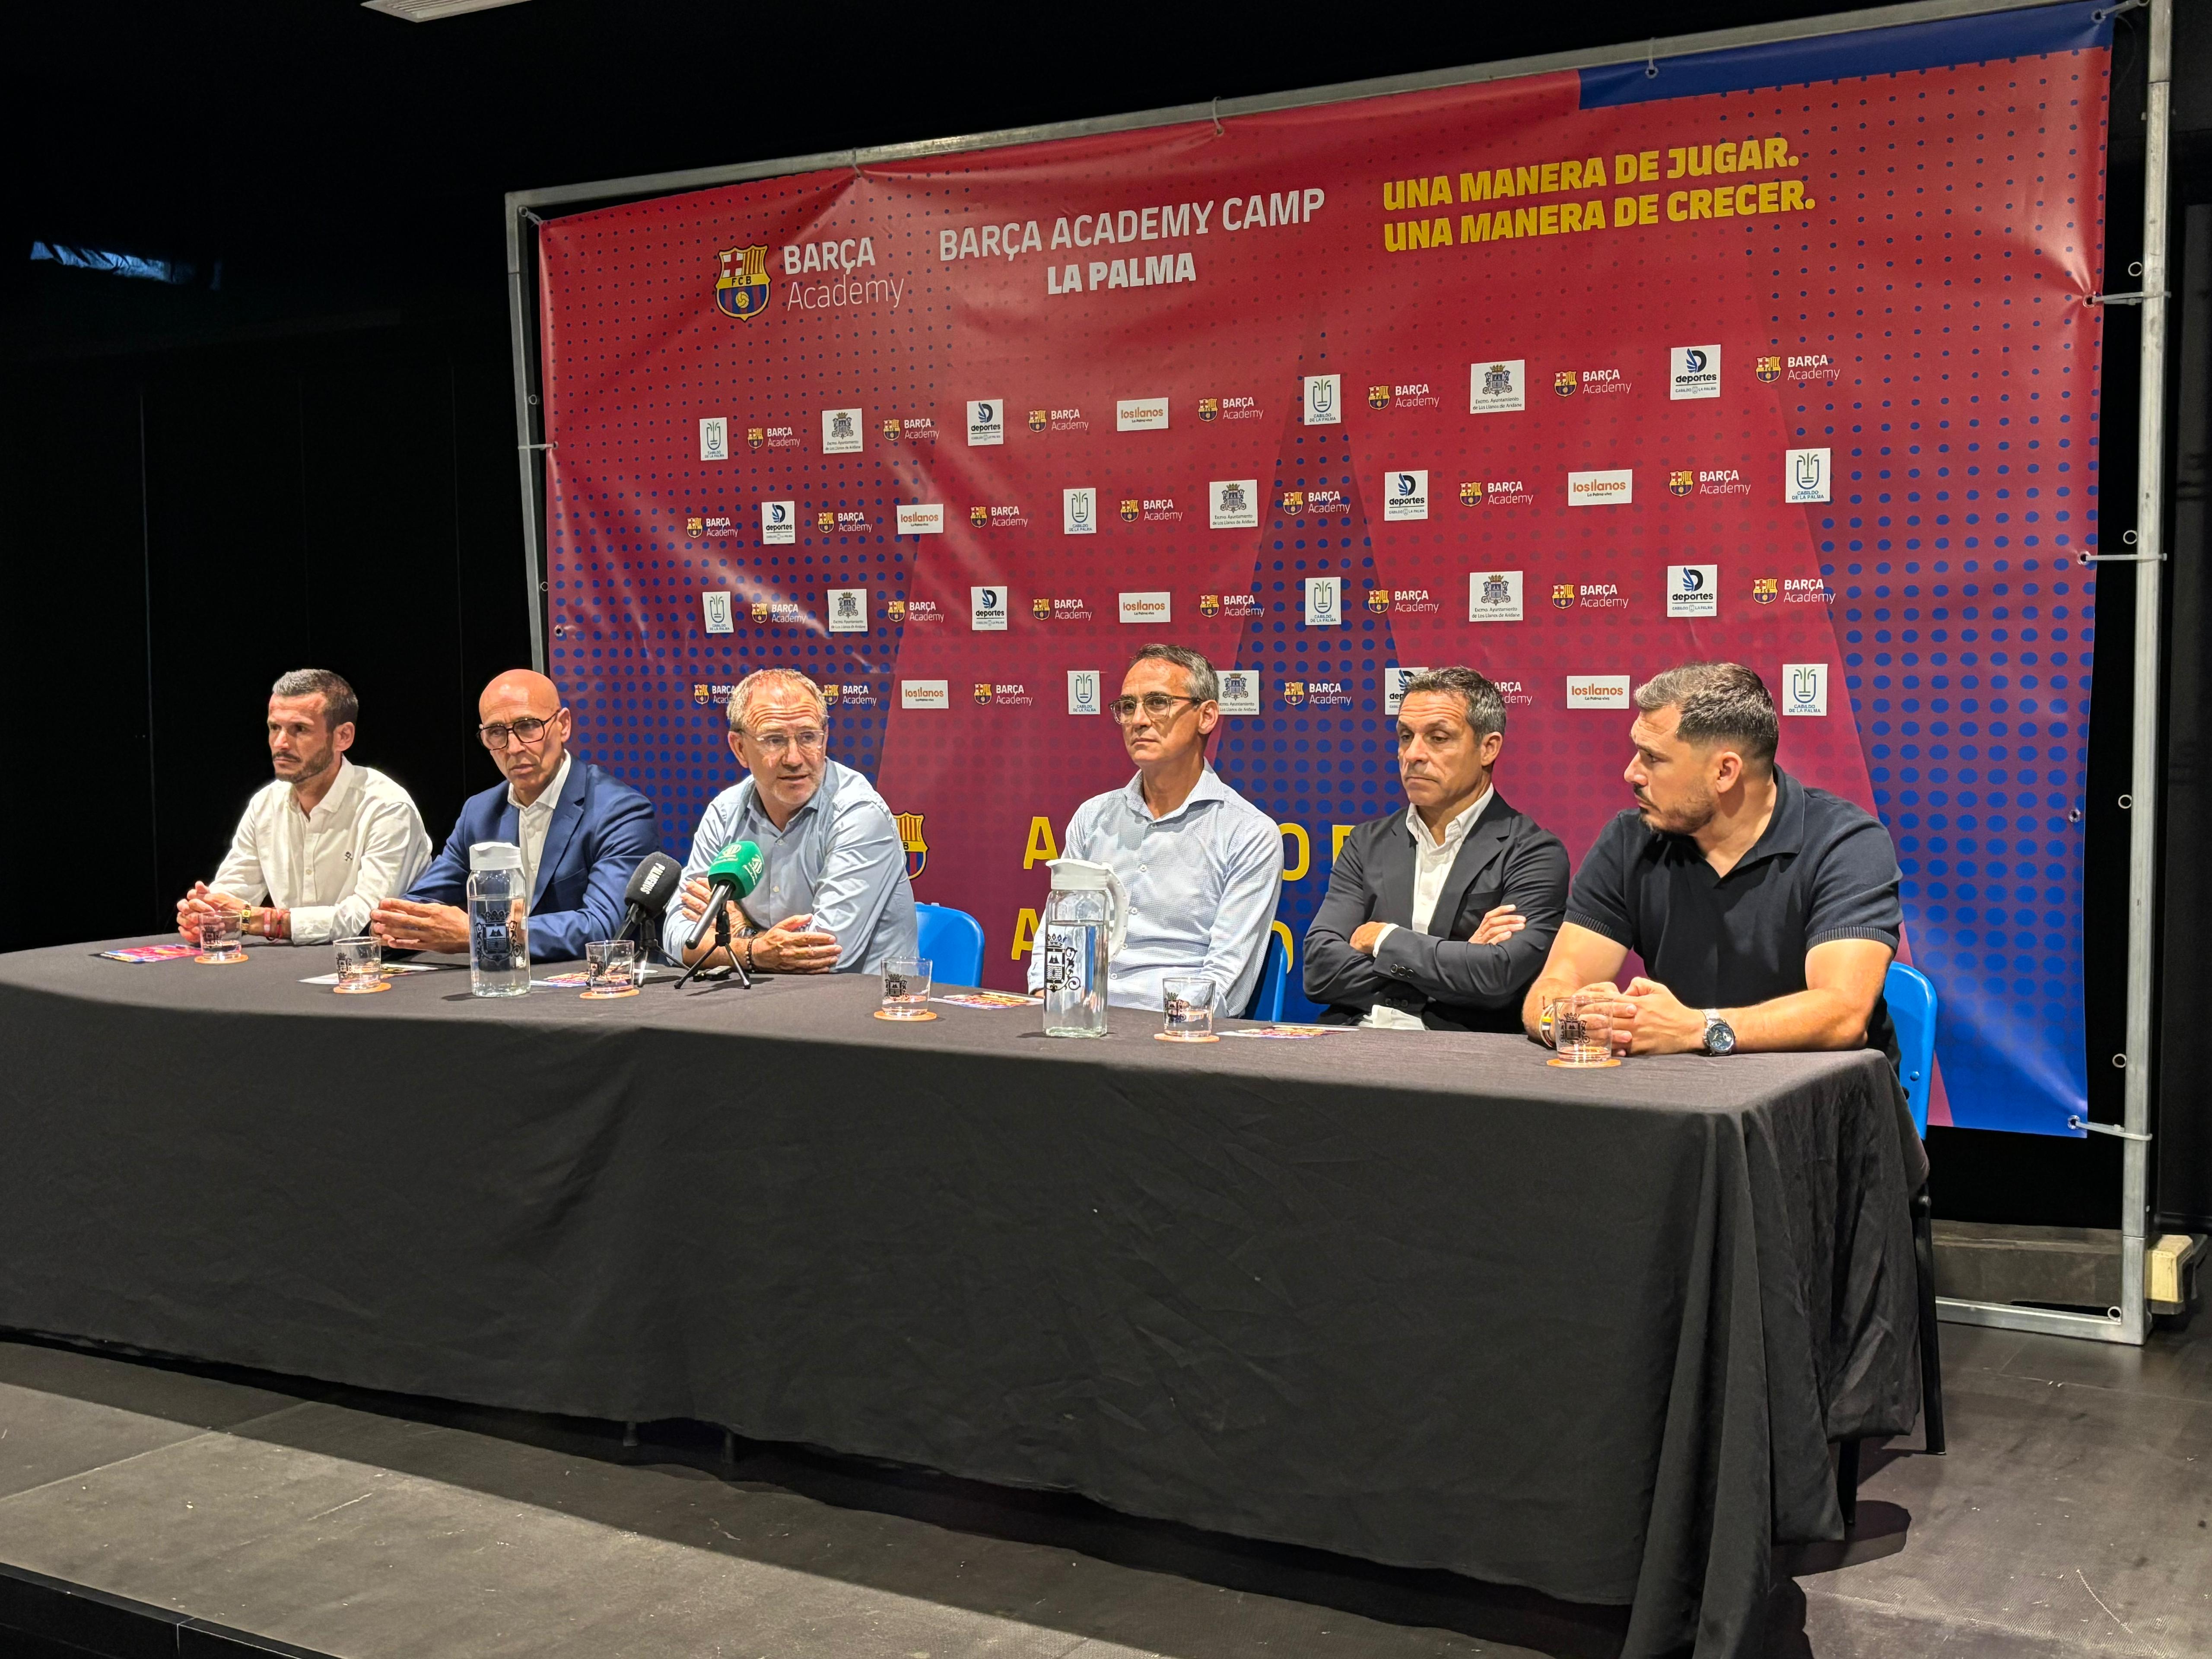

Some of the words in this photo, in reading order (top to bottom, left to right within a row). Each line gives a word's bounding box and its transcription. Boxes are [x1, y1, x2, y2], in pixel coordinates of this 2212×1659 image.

[1384, 175, 1453, 211] UNA
[1461, 158, 1606, 203] MANERA
[1615, 150, 1660, 182] DE
[1667, 138, 1799, 179] JUGAR.
[1385, 217, 1453, 252] UNA
[1461, 199, 1606, 244] MANERA
[1615, 191, 1658, 227] DE
[1667, 180, 1816, 220] CRECER.
[939, 220, 1042, 262] BARÇA
[1051, 200, 1214, 250] ACADEMY
[1223, 188, 1325, 230] CAMP
[783, 238, 875, 274] BARÇA
[1048, 265, 1083, 294] LA
[1090, 253, 1196, 290] PALMA
[732, 276, 752, 286] FCB
[788, 273, 904, 312] Academy
[1787, 355, 1828, 368] BARÇA
[1583, 369, 1620, 382] BARÇA
[1676, 374, 1716, 383] deportes
[1787, 366, 1840, 380] Academy
[1395, 384, 1429, 396] BARÇA
[1583, 381, 1631, 394] Academy
[1223, 397, 1254, 408] BARÇA
[1395, 394, 1440, 407] Academy
[1051, 409, 1080, 420] BARÇA
[1223, 407, 1264, 419] Academy
[904, 418, 931, 429] BARÇA
[1052, 420, 1088, 431] Academy
[767, 427, 792, 439] BARÇA
[905, 428, 939, 440] Academy
[768, 437, 800, 447] Academy
[1700, 470, 1739, 482] BARÇA
[1488, 481, 1523, 493] BARÇA
[1700, 481, 1751, 495] Academy
[1308, 491, 1340, 503] BARÇA
[1389, 498, 1424, 507] deportes
[1488, 493, 1533, 505] Academy
[1144, 499, 1173, 511] BARÇA
[1308, 502, 1351, 514] Academy
[838, 512, 864, 524] BARÇA
[991, 506, 1020, 518] BARÇA
[1144, 509, 1182, 521] Academy
[706, 518, 731, 529] BARÇA
[839, 522, 872, 532] Academy
[992, 516, 1028, 527] Academy
[706, 527, 738, 537] Academy
[1580, 584, 1618, 597] BARÇA
[1784, 579, 1824, 592] BARÇA
[1224, 595, 1255, 607] BARÇA
[1395, 590, 1429, 602] BARÇA
[1672, 593, 1713, 602] deportes
[1784, 590, 1836, 604] Academy
[909, 601, 936, 613] BARÇA
[1054, 599, 1083, 610] BARÇA
[1395, 601, 1439, 613] Academy
[1580, 596, 1629, 609] Academy
[772, 604, 798, 614] BARÇA
[1055, 609, 1092, 621] Academy
[1224, 606, 1265, 617] Academy
[772, 613, 806, 623] Academy
[909, 612, 944, 623] Academy
[842, 685, 868, 697] BARÇA
[996, 685, 1024, 696] BARÇA
[1309, 683, 1341, 695] BARÇA
[1495, 681, 1522, 693] ARÇA
[713, 695, 730, 703] Acad
[843, 695, 877, 706] Academy
[996, 695, 1033, 706] Academy
[1309, 694, 1351, 706] Academy
[1503, 693, 1532, 706] demy
